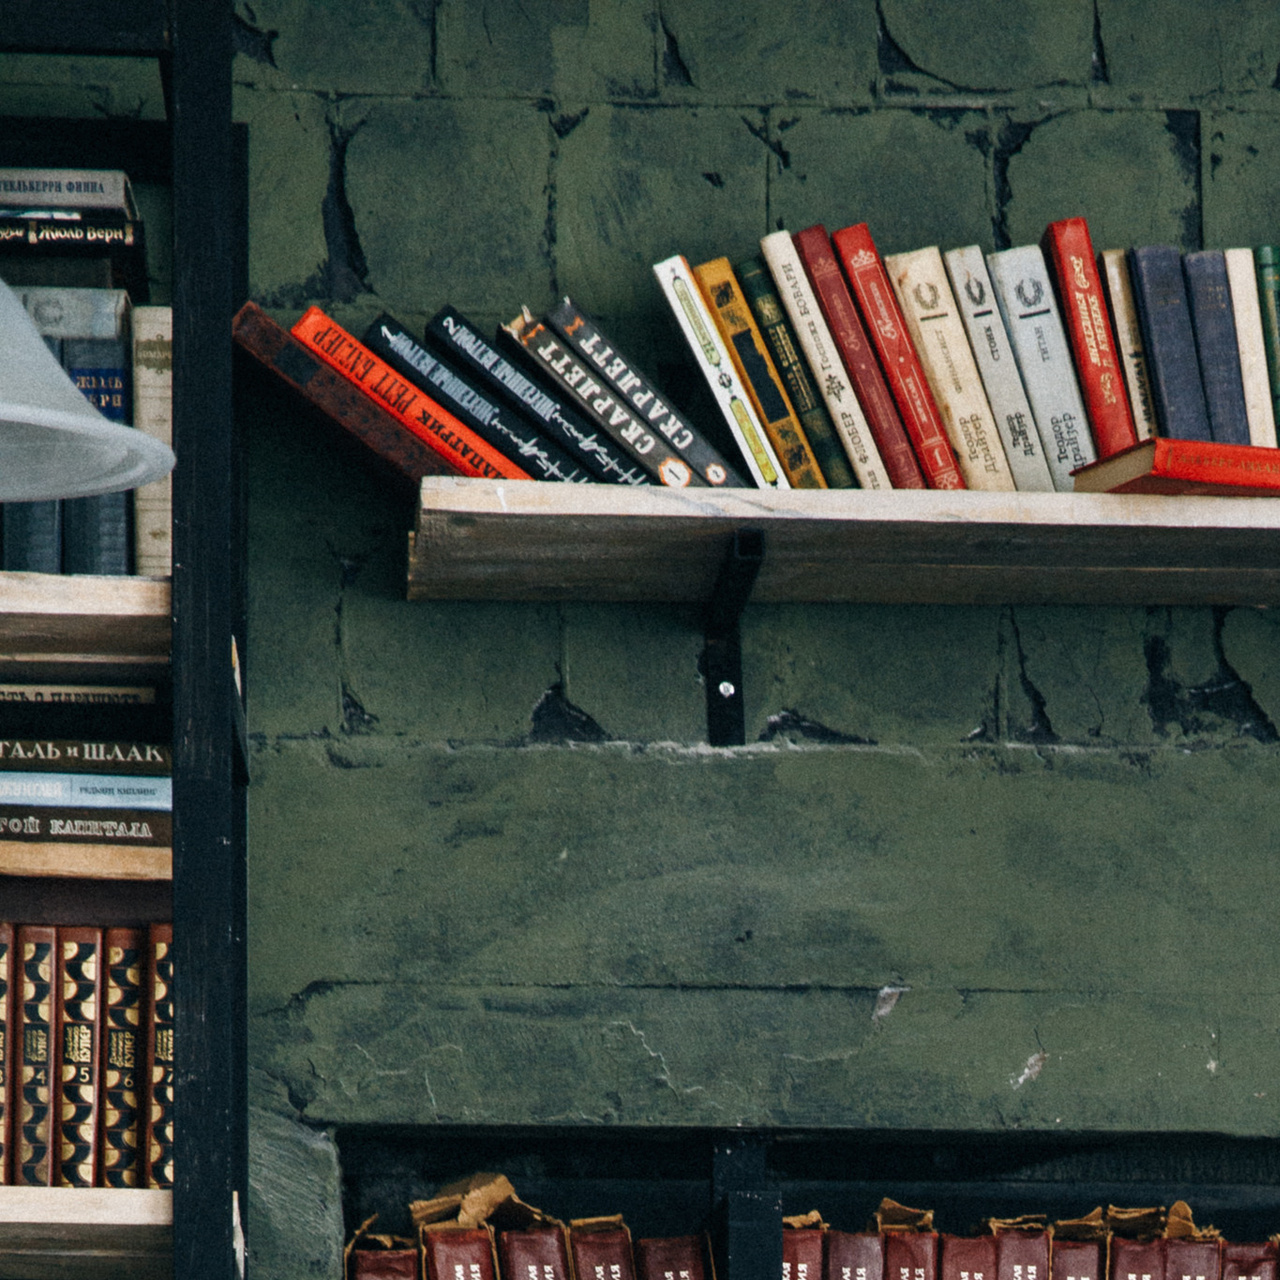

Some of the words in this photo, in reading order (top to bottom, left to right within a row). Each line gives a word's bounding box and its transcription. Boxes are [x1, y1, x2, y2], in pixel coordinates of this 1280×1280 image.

[66, 182, 104, 193] ФИННА
[38, 226, 84, 240] Жюль
[86, 227, 124, 243] Верн
[781, 262, 811, 317] БОВАРИ
[442, 316, 458, 336] 2
[983, 325, 1000, 361] СТОИК
[1034, 325, 1050, 363] ТИТАН
[370, 372, 418, 415] РЕТТ
[537, 341, 656, 455] СКАРЛЕТТ
[579, 333, 694, 450] СКАРЛЕТТ
[841, 412, 869, 464] ФЛОБЕР
[958, 416, 980, 462] Теодор
[970, 413, 999, 473] Драйзер
[1051, 416, 1070, 464] Теодор
[933, 450, 945, 467] 1
[83, 743, 163, 762] ШЛАК
[50, 819, 152, 838] КАПИТАЛА
[80, 1025, 91, 1063] КУПЕР
[124, 1031, 135, 1068] КУПЕР
[36, 1069, 46, 1084] 4
[79, 1067, 90, 1082] 5
[123, 1073, 134, 1087] 6
